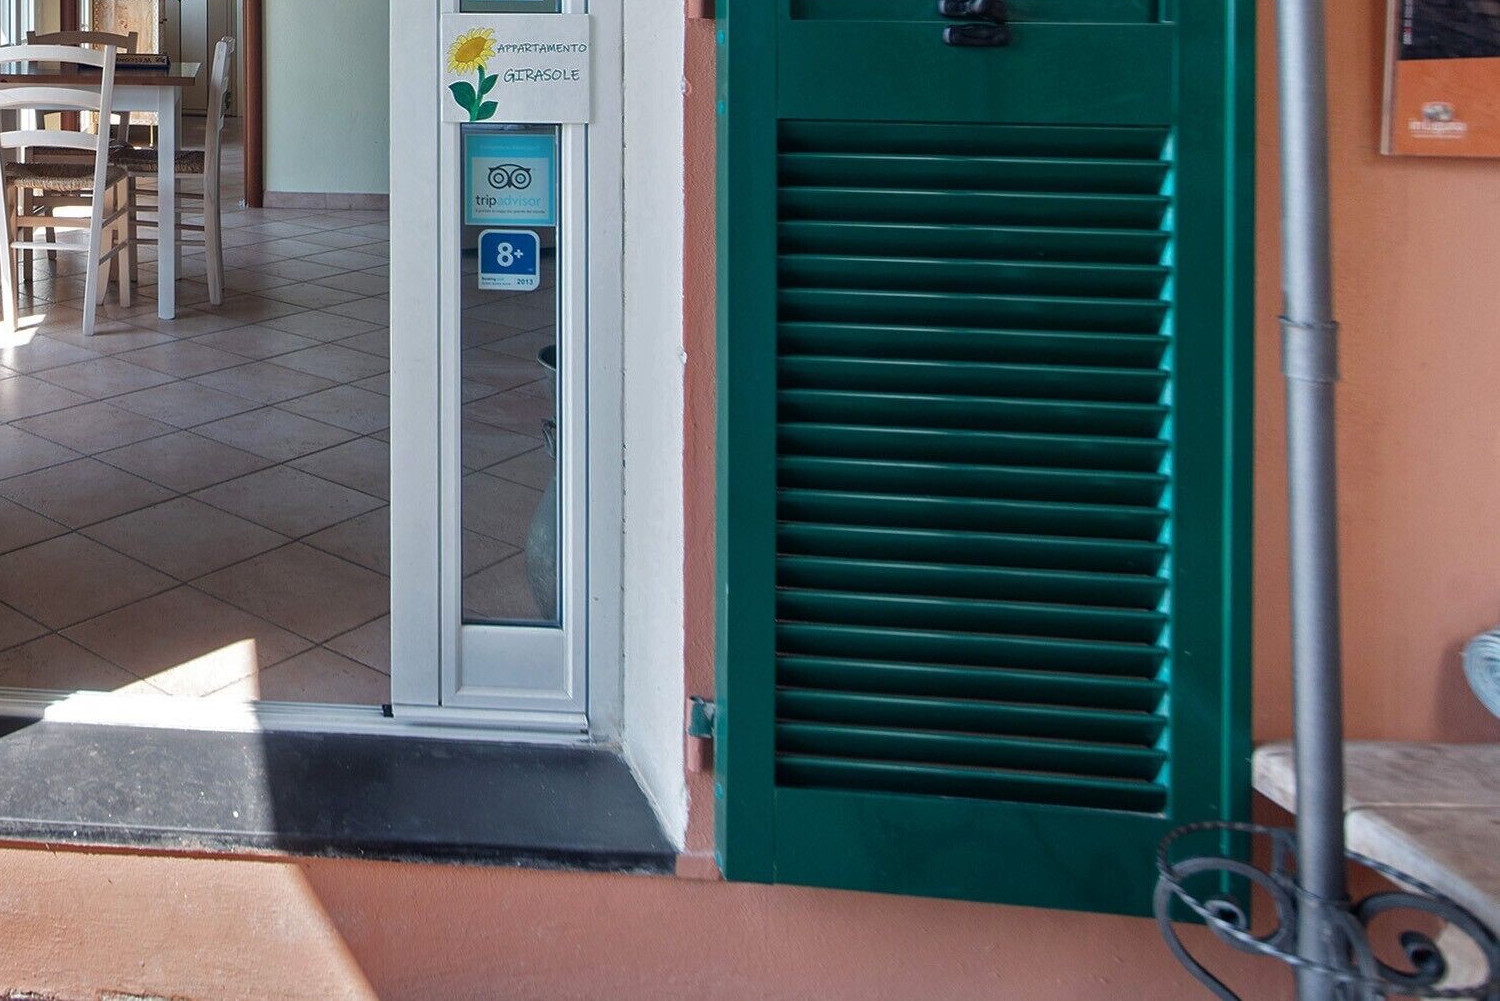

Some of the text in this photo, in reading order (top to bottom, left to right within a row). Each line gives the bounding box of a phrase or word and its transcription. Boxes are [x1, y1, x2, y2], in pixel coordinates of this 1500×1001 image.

[497, 42, 588, 54] APPARTAMENTO
[503, 68, 580, 83] GIRASOLE
[475, 194, 541, 208] tripadvisor
[516, 278, 534, 286] 2013
